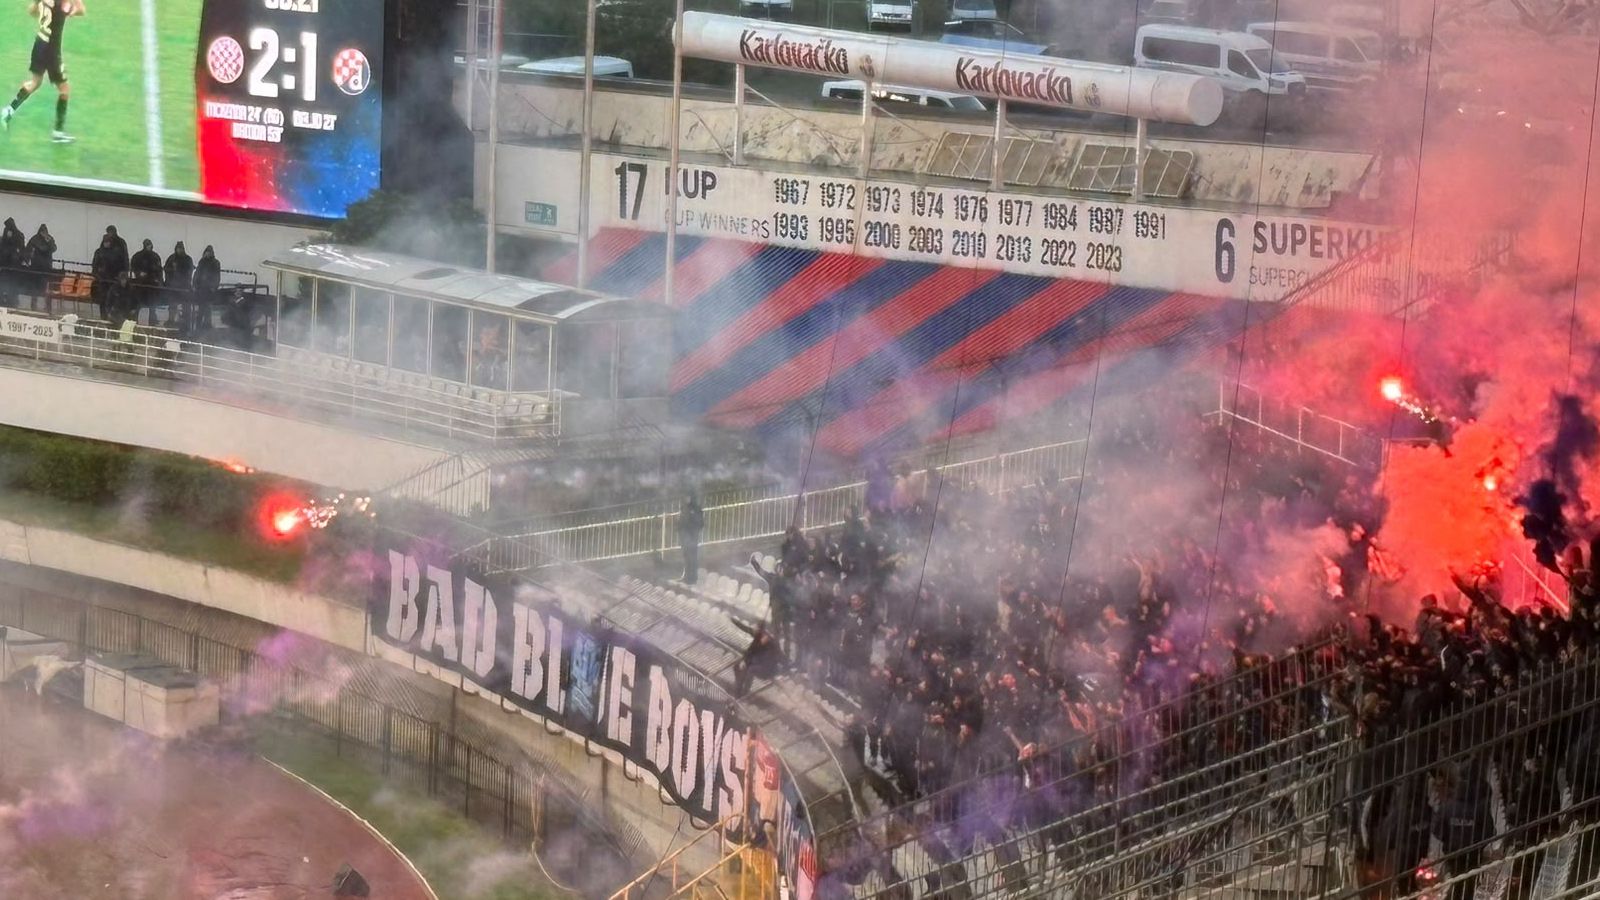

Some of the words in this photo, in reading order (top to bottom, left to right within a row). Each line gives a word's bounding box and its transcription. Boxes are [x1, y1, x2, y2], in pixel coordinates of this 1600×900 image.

[249, 28, 317, 101] 2:1
[740, 29, 849, 74] Karlovačko
[955, 56, 1073, 104] Karlovačko
[615, 161, 648, 221] 17
[773, 178, 810, 205] 1967
[819, 183, 856, 209] 1972
[864, 186, 901, 213] 1973
[910, 190, 945, 218] 1974
[953, 195, 988, 223] 1976
[998, 198, 1033, 227] 1977
[1042, 202, 1078, 232] 1984
[1087, 206, 1124, 235] 1987
[1133, 210, 1167, 240] 1991
[699, 211, 770, 239] WINNERS
[773, 211, 809, 241] 1993
[819, 216, 855, 245] 1995
[864, 220, 901, 250] 2000
[908, 225, 944, 255] 2003
[952, 229, 988, 259] 2010
[996, 234, 1033, 263] 2013
[1041, 238, 1077, 268] 2022
[1086, 242, 1123, 273] 2023
[1215, 217, 1236, 284] 6
[386, 549, 498, 679] BAD
[645, 665, 748, 832] BOYS
